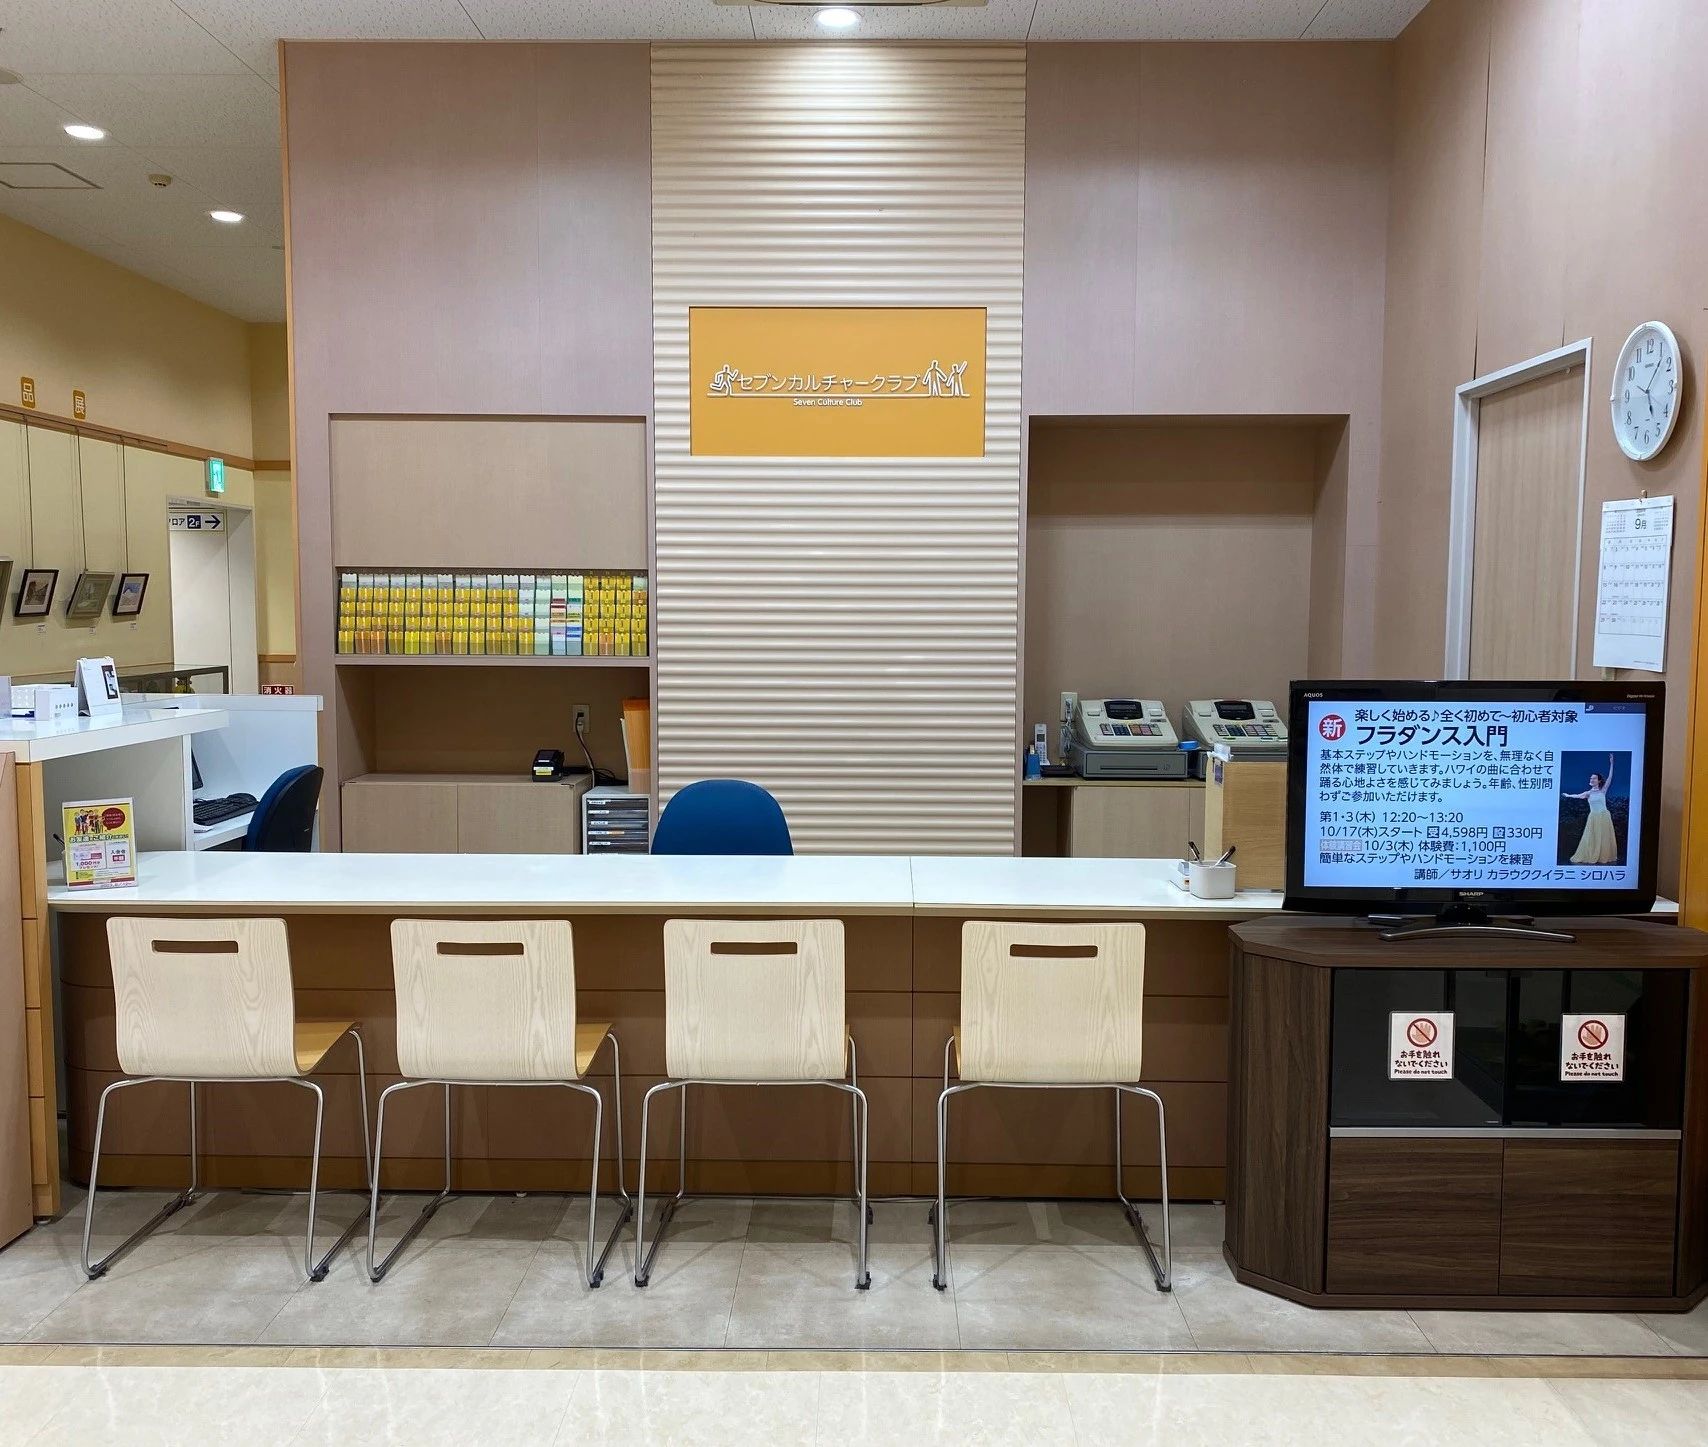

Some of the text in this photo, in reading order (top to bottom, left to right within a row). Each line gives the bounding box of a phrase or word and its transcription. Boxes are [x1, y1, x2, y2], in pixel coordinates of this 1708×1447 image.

[737, 374, 921, 392] セブンカルチャークラブ
[22, 383, 34, 402] 品
[817, 398, 843, 406] Culture
[1635, 518, 1647, 529] 9月
[1322, 719, 1343, 738] 新
[1356, 724, 1507, 746] フラダンス入門
[1320, 749, 1554, 761] 基本ステップやハンドモーションを、無理なく自
[1319, 764, 1554, 775] 然体で練習していきます。ハワイの曲に合わせて
[1319, 778, 1553, 790] 踊る心地よさを感じてみましょう。年齢、性別問
[1319, 791, 1443, 803] わずご参加いただけます。
[1320, 827, 1422, 838] 10/17(木)スタート
[1365, 841, 1414, 852] 10/3(木)
[1319, 853, 1534, 865] 簡単なステップやハンドモーションを練習
[1487, 869, 1576, 880] カラウククイラニ
[1581, 870, 1626, 881] シロハラ
[1400, 1050, 1440, 1058] お手を触れ
[1571, 1052, 1612, 1061] お手を触れ
[1395, 1060, 1448, 1068] ないでください
[1566, 1062, 1619, 1070] ないでください
